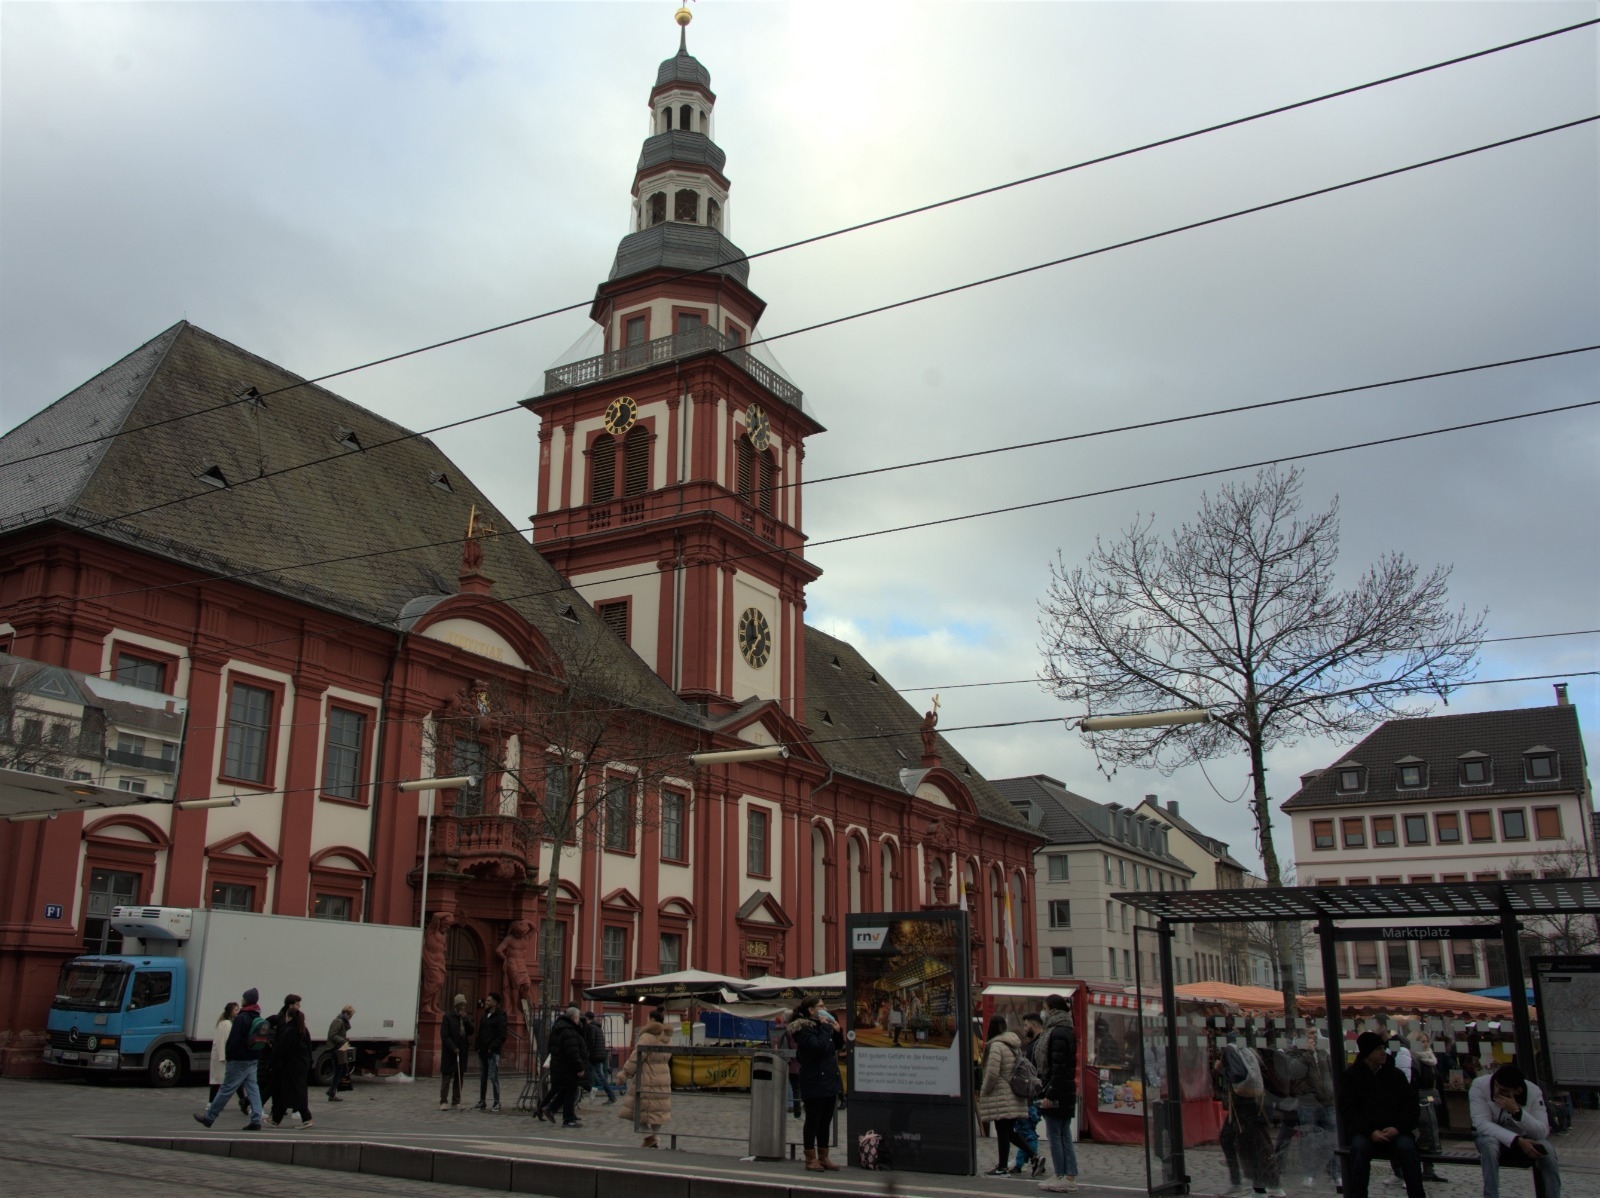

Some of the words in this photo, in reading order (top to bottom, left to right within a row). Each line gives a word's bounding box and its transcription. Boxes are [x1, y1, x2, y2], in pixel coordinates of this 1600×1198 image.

[857, 932, 880, 942] rnv
[1382, 927, 1451, 940] Marktplatz
[869, 1053, 886, 1061] gutem
[888, 1052, 905, 1060] Gefühl
[705, 1066, 738, 1082] Spatz
[902, 1132, 921, 1141] Wall
